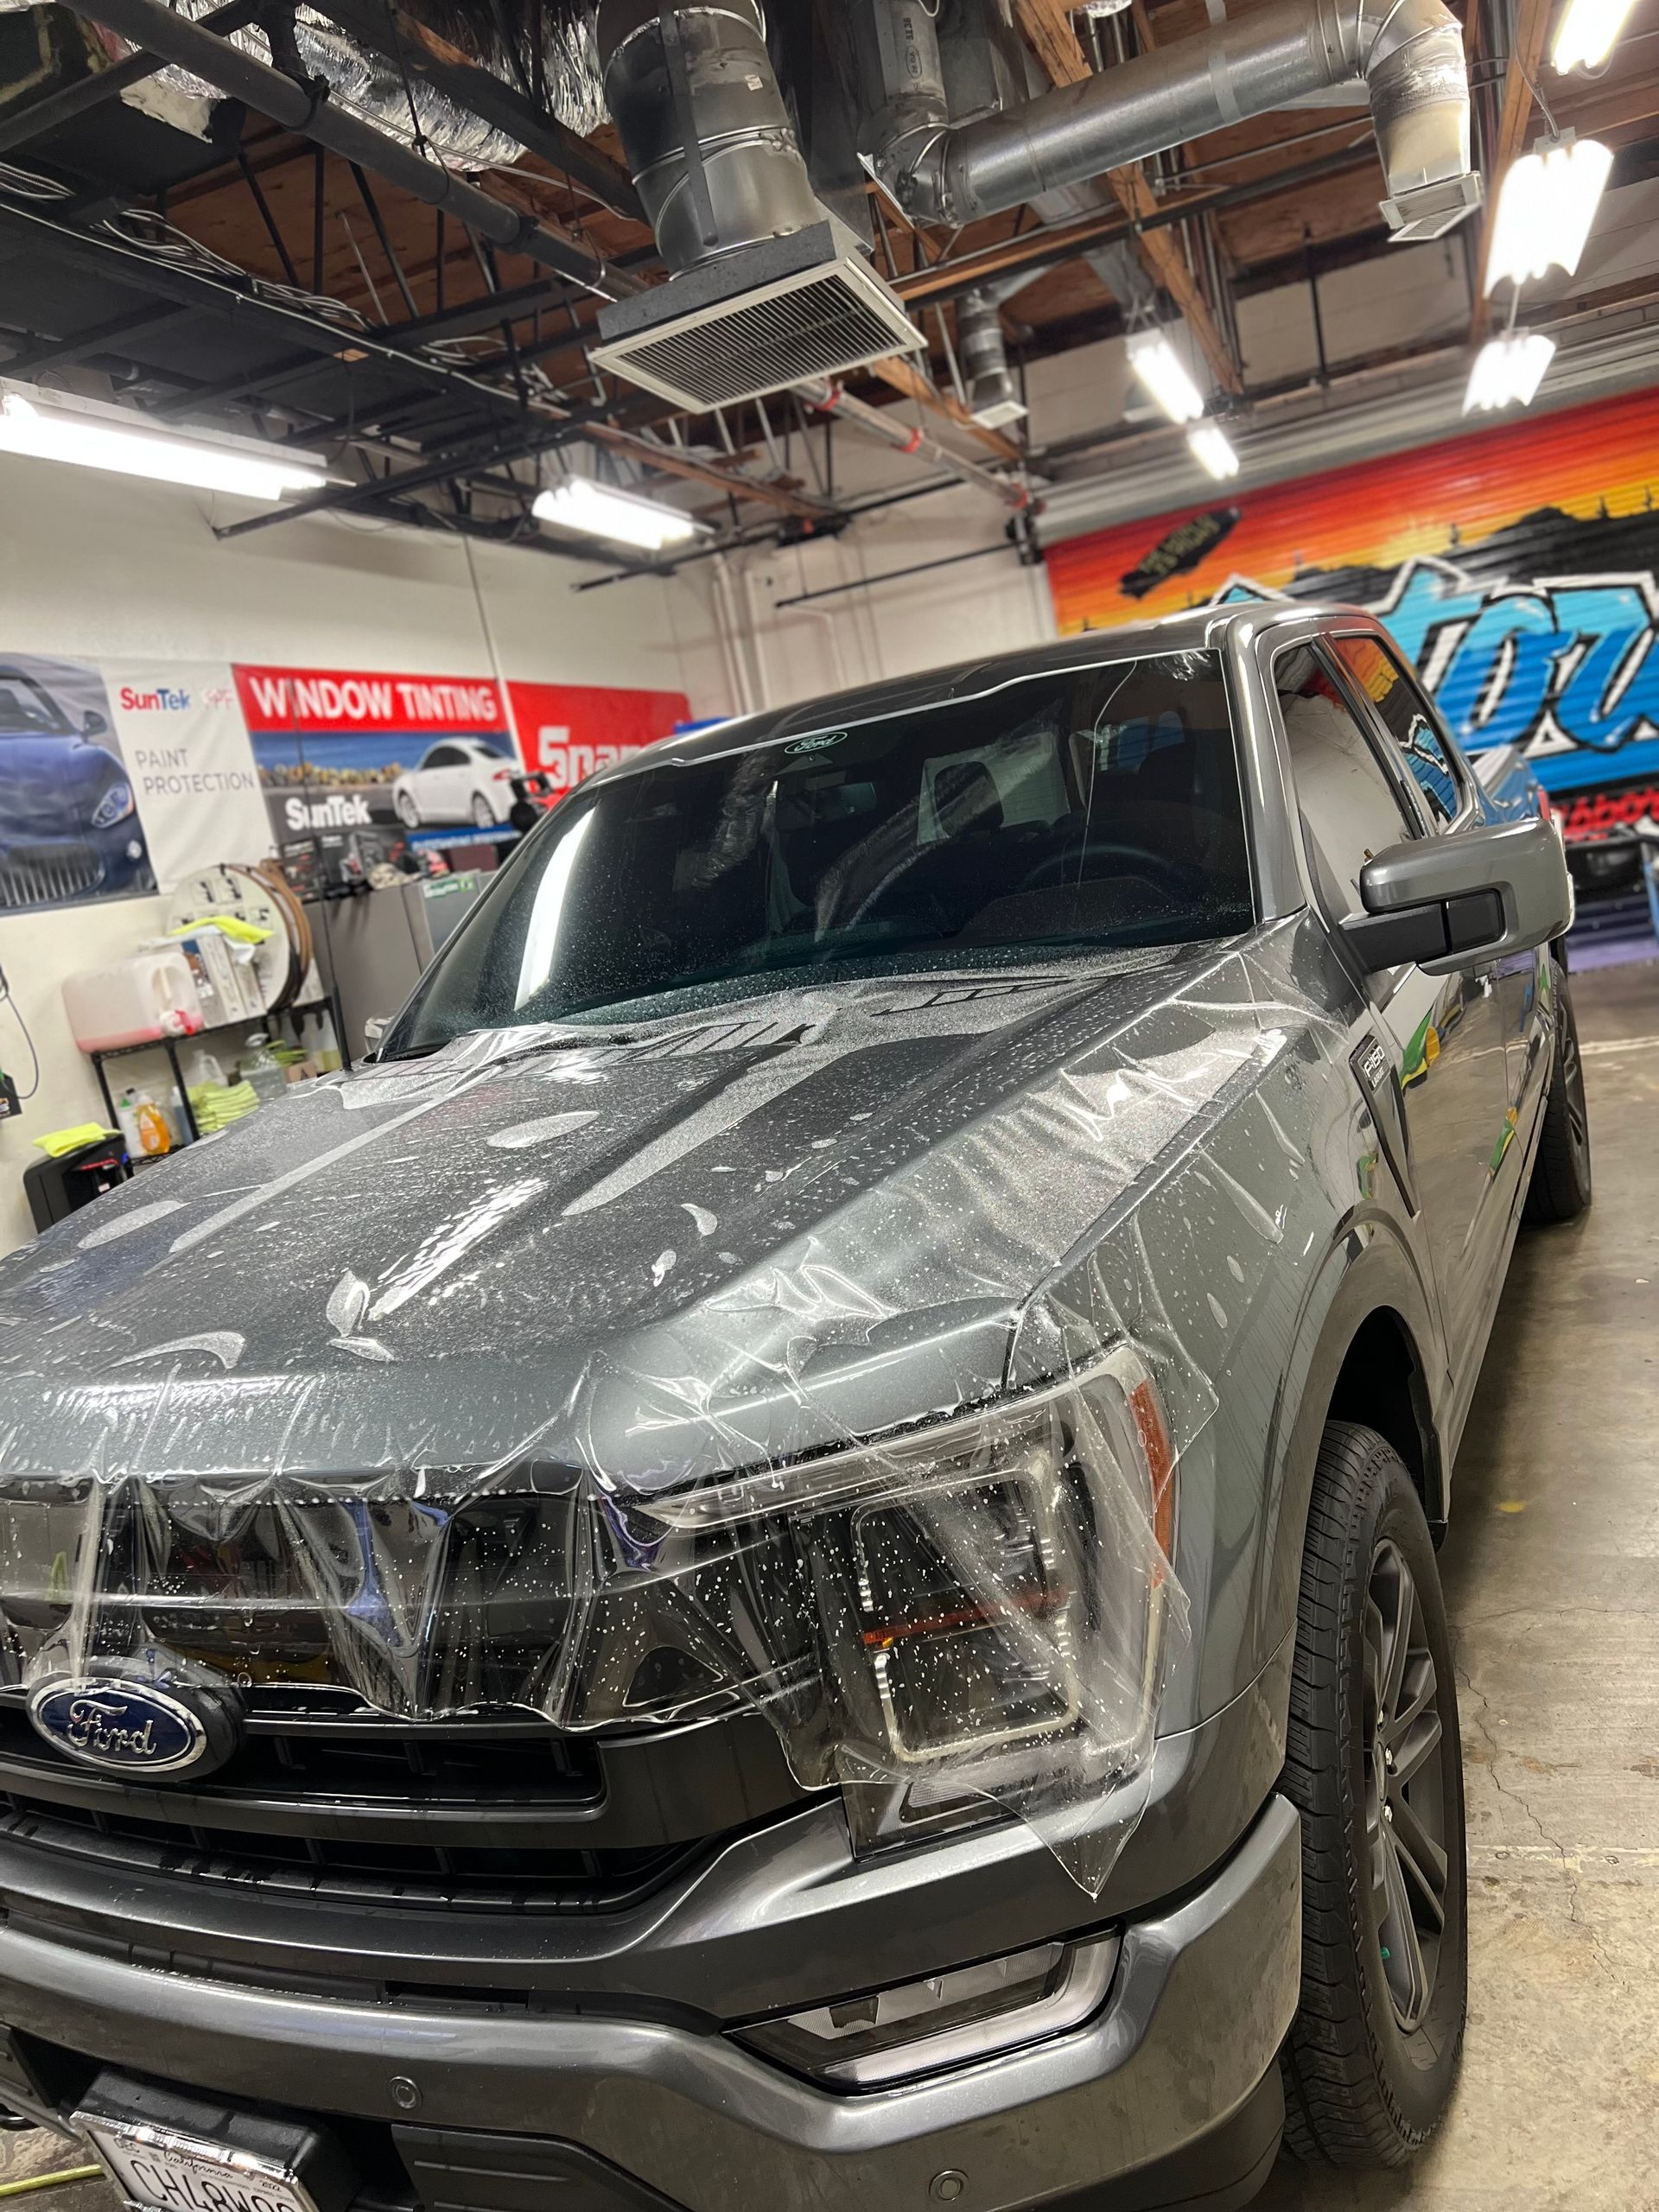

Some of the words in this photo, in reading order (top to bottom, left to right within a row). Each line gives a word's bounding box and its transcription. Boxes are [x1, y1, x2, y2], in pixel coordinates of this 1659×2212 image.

[120, 686, 191, 710] SunTek
[249, 677, 393, 721] WINDOW
[396, 682, 499, 721] TINTING
[794, 734, 837, 752] Ford
[135, 747, 189, 770] PAINT
[142, 772, 255, 795] PROTECTION
[285, 792, 372, 830] SunTek
[67, 1699, 157, 1755] Ford
